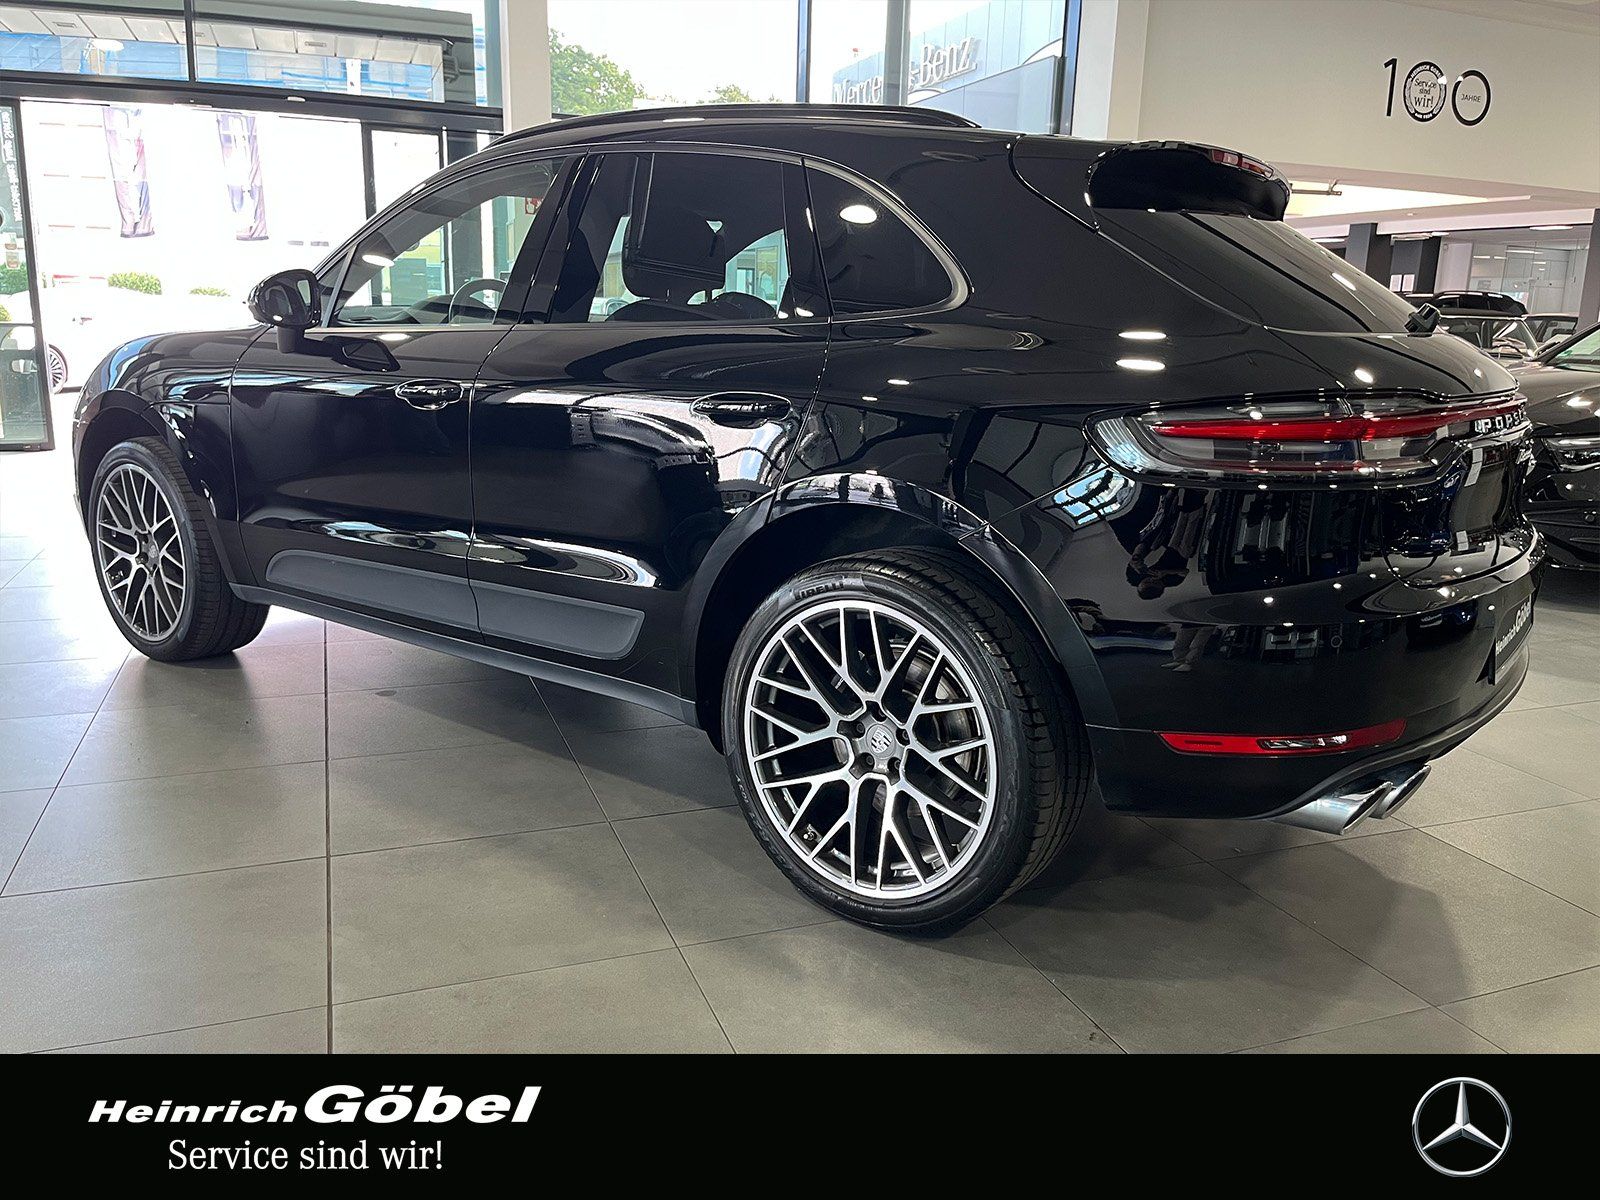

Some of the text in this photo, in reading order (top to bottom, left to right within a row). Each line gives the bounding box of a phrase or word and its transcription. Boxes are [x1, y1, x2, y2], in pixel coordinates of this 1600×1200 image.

[1414, 78, 1437, 89] Service
[1384, 58, 1491, 126] 100
[1414, 95, 1434, 108] wir!
[1461, 94, 1481, 103] JAHRE
